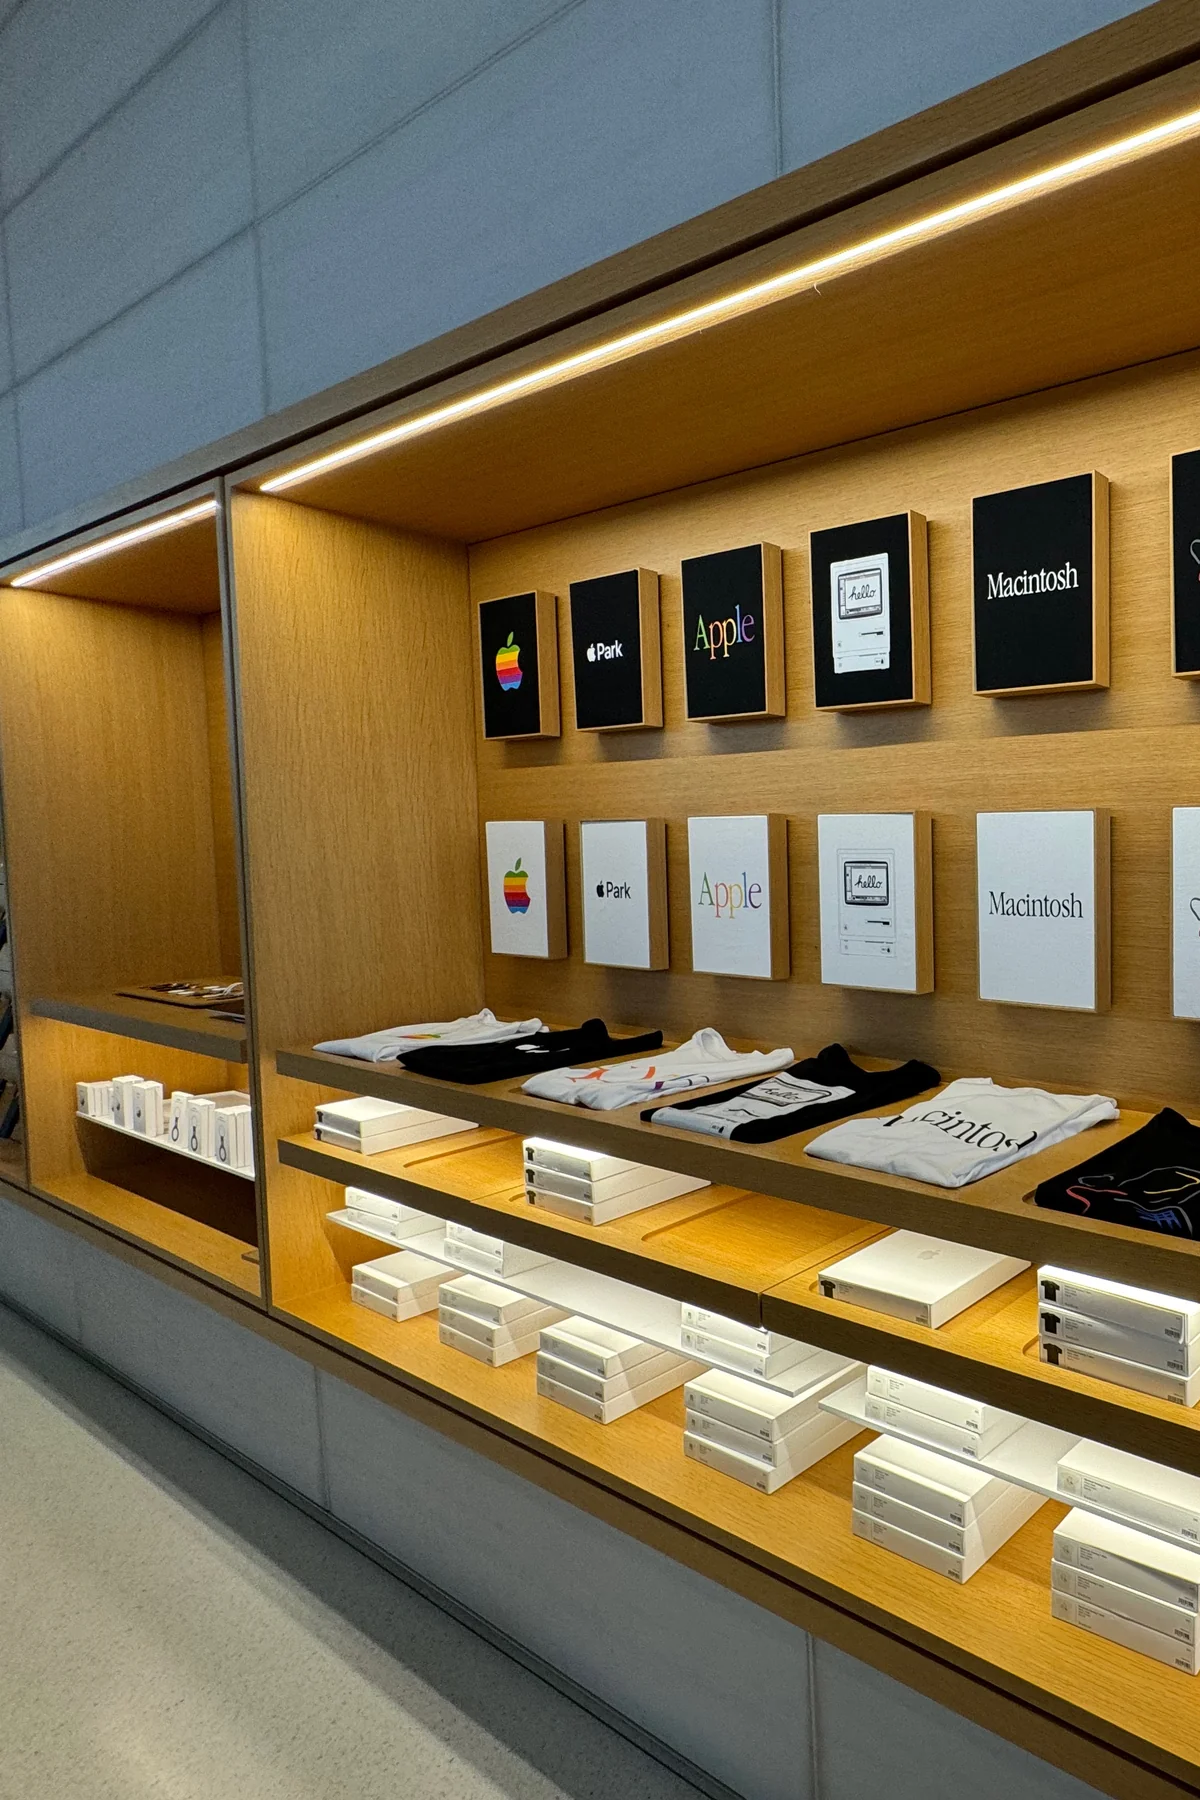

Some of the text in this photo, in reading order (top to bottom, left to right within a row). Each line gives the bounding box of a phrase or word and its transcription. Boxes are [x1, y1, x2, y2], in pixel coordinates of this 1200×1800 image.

[986, 561, 1080, 601] Macintosh
[693, 604, 756, 661] Apple
[596, 639, 624, 661] Park
[606, 881, 632, 899] Park
[698, 871, 763, 919] Apple
[988, 890, 1084, 919] Macintosh
